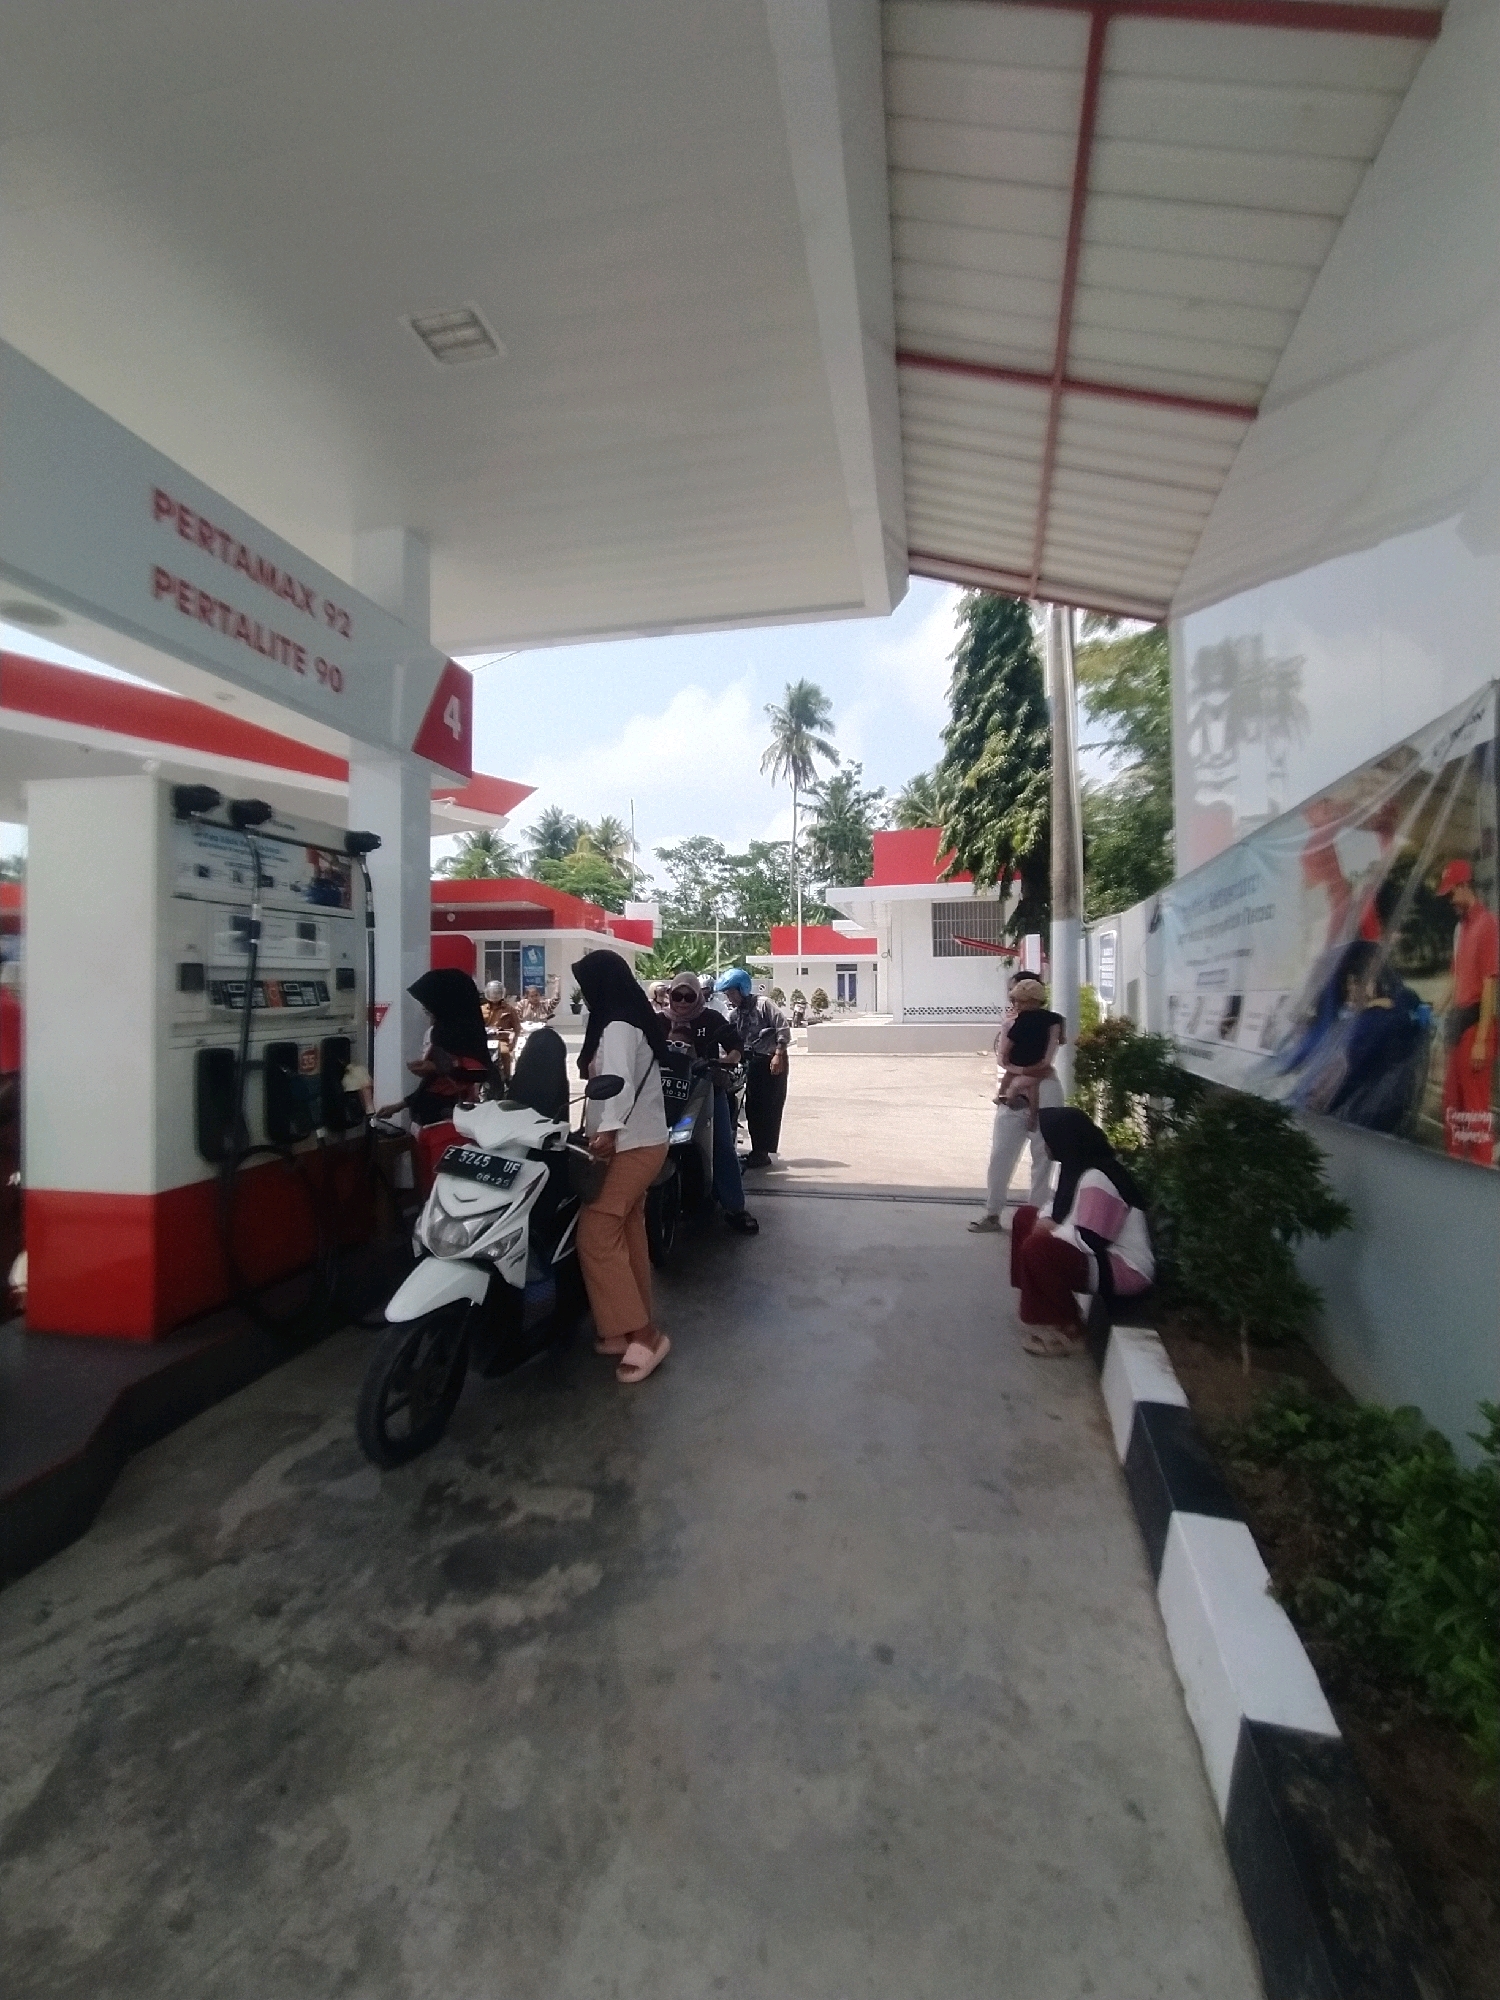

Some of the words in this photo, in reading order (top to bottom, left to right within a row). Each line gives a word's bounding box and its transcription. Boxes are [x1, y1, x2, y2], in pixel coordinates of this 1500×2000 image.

[153, 487, 317, 619] PERTAMAX
[323, 599, 352, 639] 92
[153, 565, 307, 675] PERTALITE
[314, 655, 345, 693] 90
[443, 694, 462, 740] 4
[696, 1027, 706, 1037] H
[444, 1148, 456, 1160] Z
[503, 1161, 521, 1174] UF
